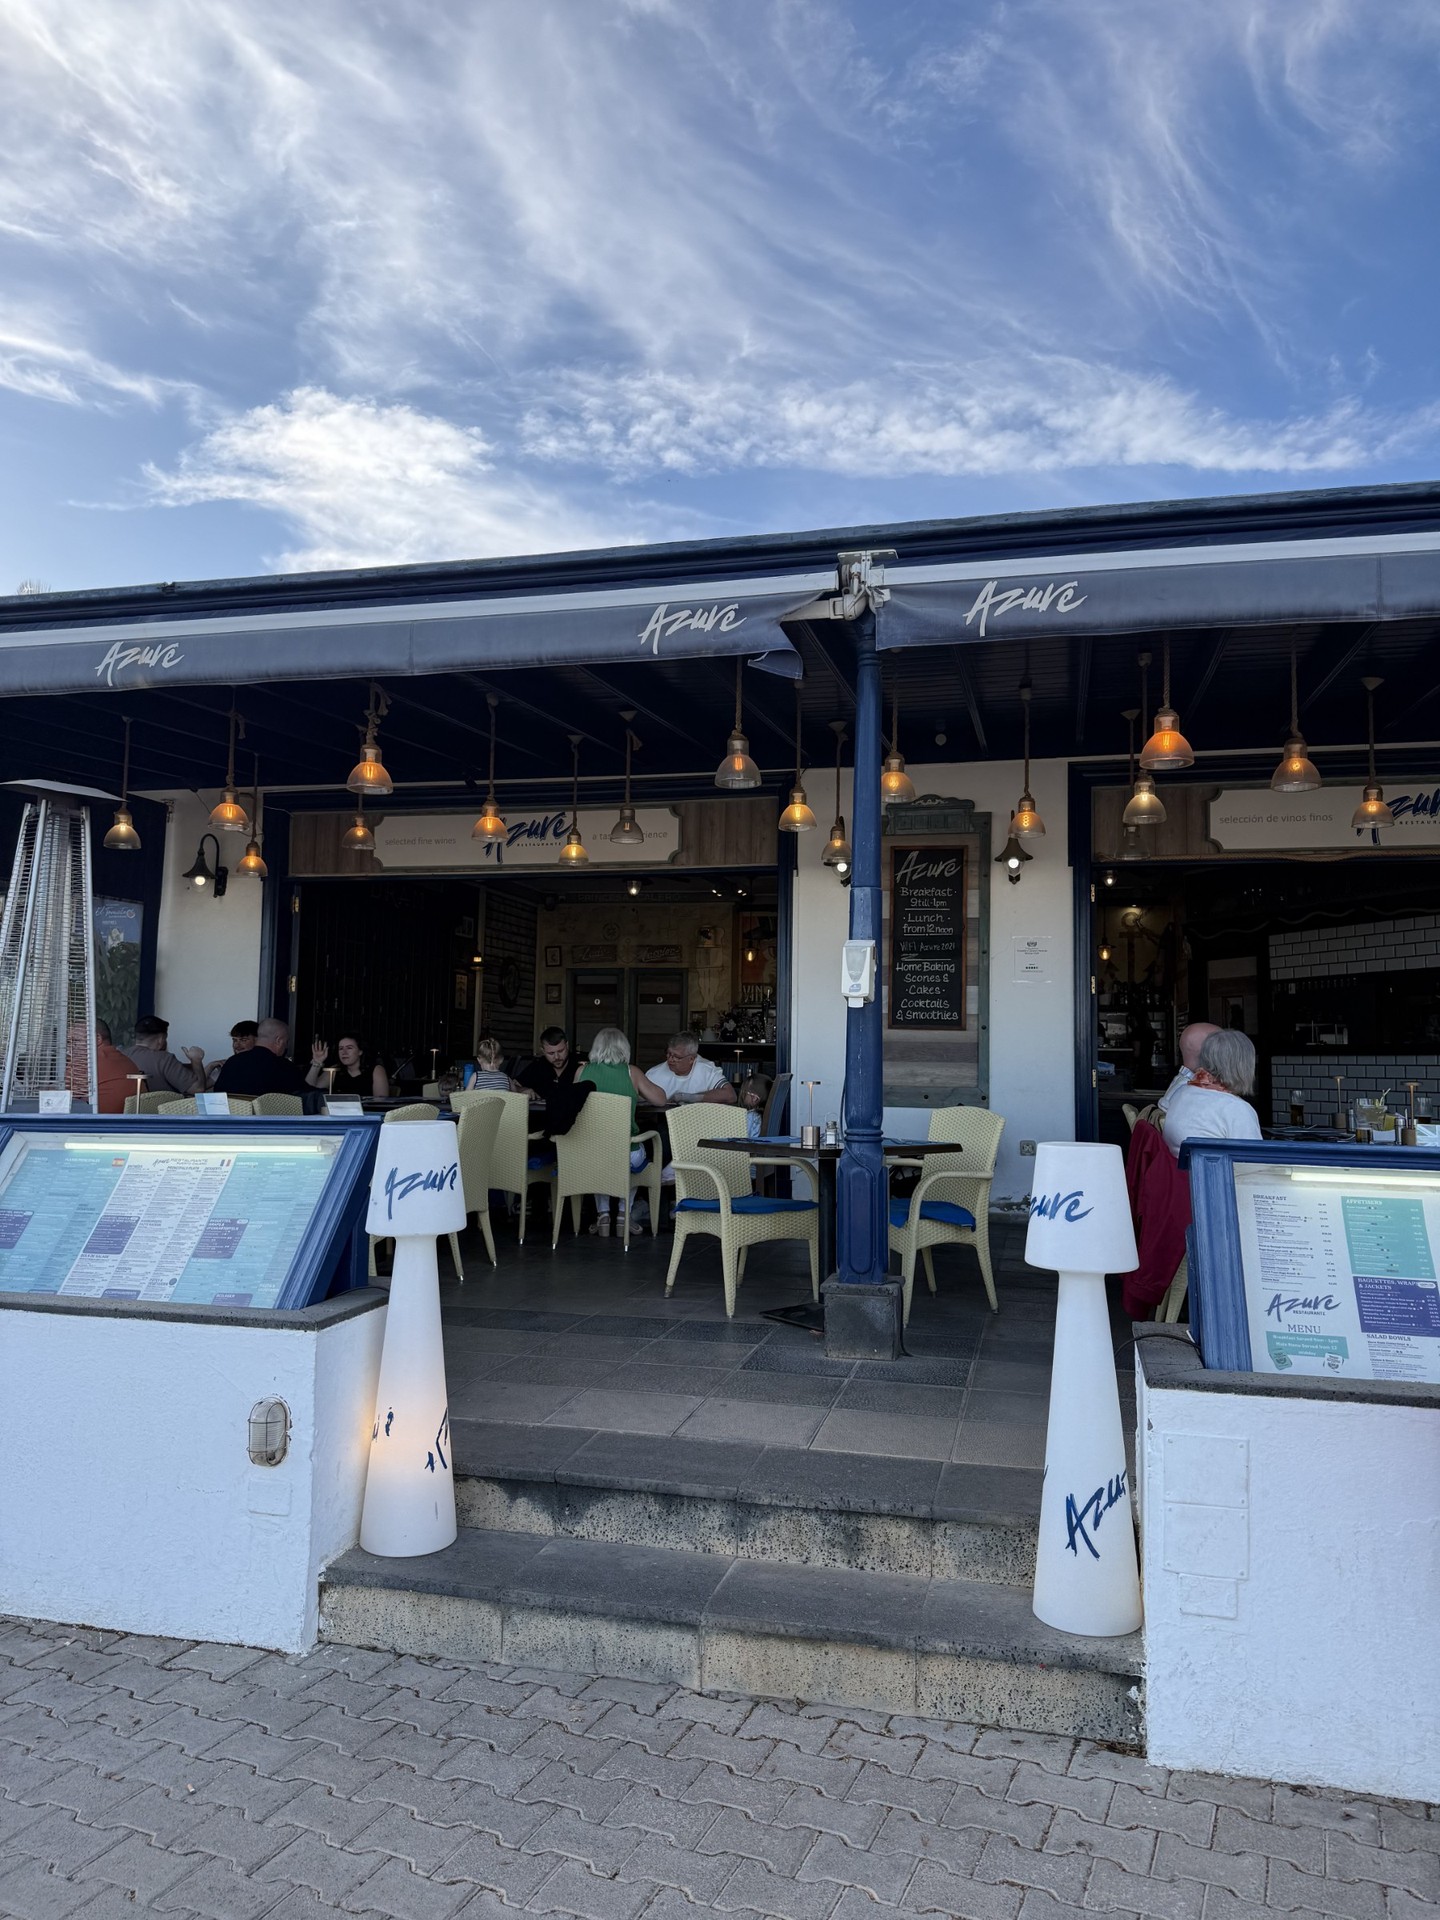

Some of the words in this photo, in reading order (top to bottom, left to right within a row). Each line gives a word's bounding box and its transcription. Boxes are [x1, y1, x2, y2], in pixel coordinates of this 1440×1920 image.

[962, 581, 1088, 637] Azure
[637, 604, 747, 655] Azure
[95, 641, 185, 687] Azure
[1219, 813, 1263, 824] selección
[1266, 814, 1279, 823] de
[1280, 814, 1307, 823] vinos
[1309, 812, 1333, 822] finos
[384, 835, 416, 846] selected
[417, 835, 431, 846] fine
[432, 835, 456, 845] wines
[894, 850, 962, 886] Azure
[900, 887, 953, 897] Breakfast
[907, 912, 944, 923] Lunch
[895, 962, 922, 972] Home
[922, 961, 956, 973] Baking
[904, 973, 941, 983] Scones
[908, 984, 941, 995] Cakes
[900, 998, 950, 1009] Cocktails
[904, 1009, 959, 1020] Smoothies
[385, 1162, 458, 1220] Azure
[1264, 1293, 1342, 1323] Azure
[1287, 1323, 1321, 1334] MENU
